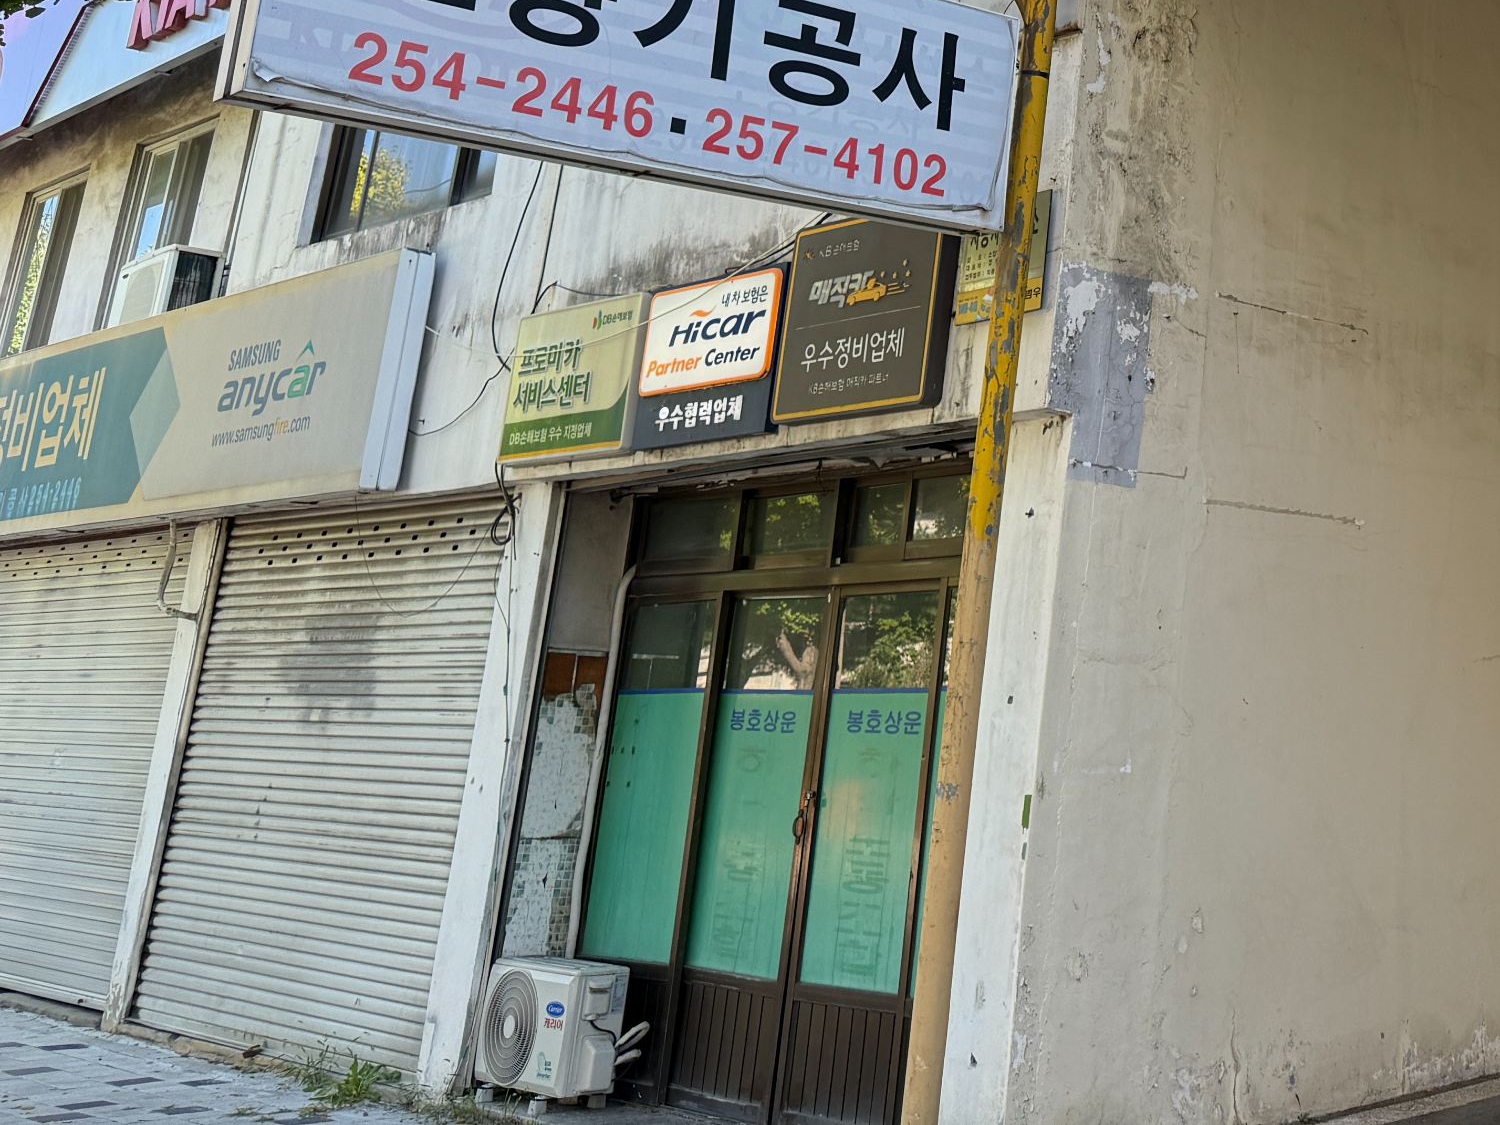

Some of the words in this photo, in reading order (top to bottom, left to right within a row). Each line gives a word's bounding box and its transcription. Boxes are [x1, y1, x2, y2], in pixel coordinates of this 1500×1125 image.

[348, 31, 655, 139] 254-2446
[703, 107, 948, 198] 257-4102
[668, 309, 767, 348] Hicar
[228, 339, 282, 372] SAMSUNG
[518, 338, 582, 376] 프로미카
[646, 355, 703, 378] Partner
[704, 346, 760, 367] Center
[801, 327, 905, 373] 우수정비업체
[217, 361, 327, 416] anycar
[513, 372, 592, 413] 서비스센터
[211, 416, 311, 448] www.samsungfire.com
[655, 394, 744, 432] 우수협력업체
[509, 426, 547, 446] DB손해보험
[548, 427, 562, 441] 우수
[563, 422, 593, 440] 지정업체
[730, 709, 797, 734] 봉호상운
[846, 709, 922, 735] 봉호상운
